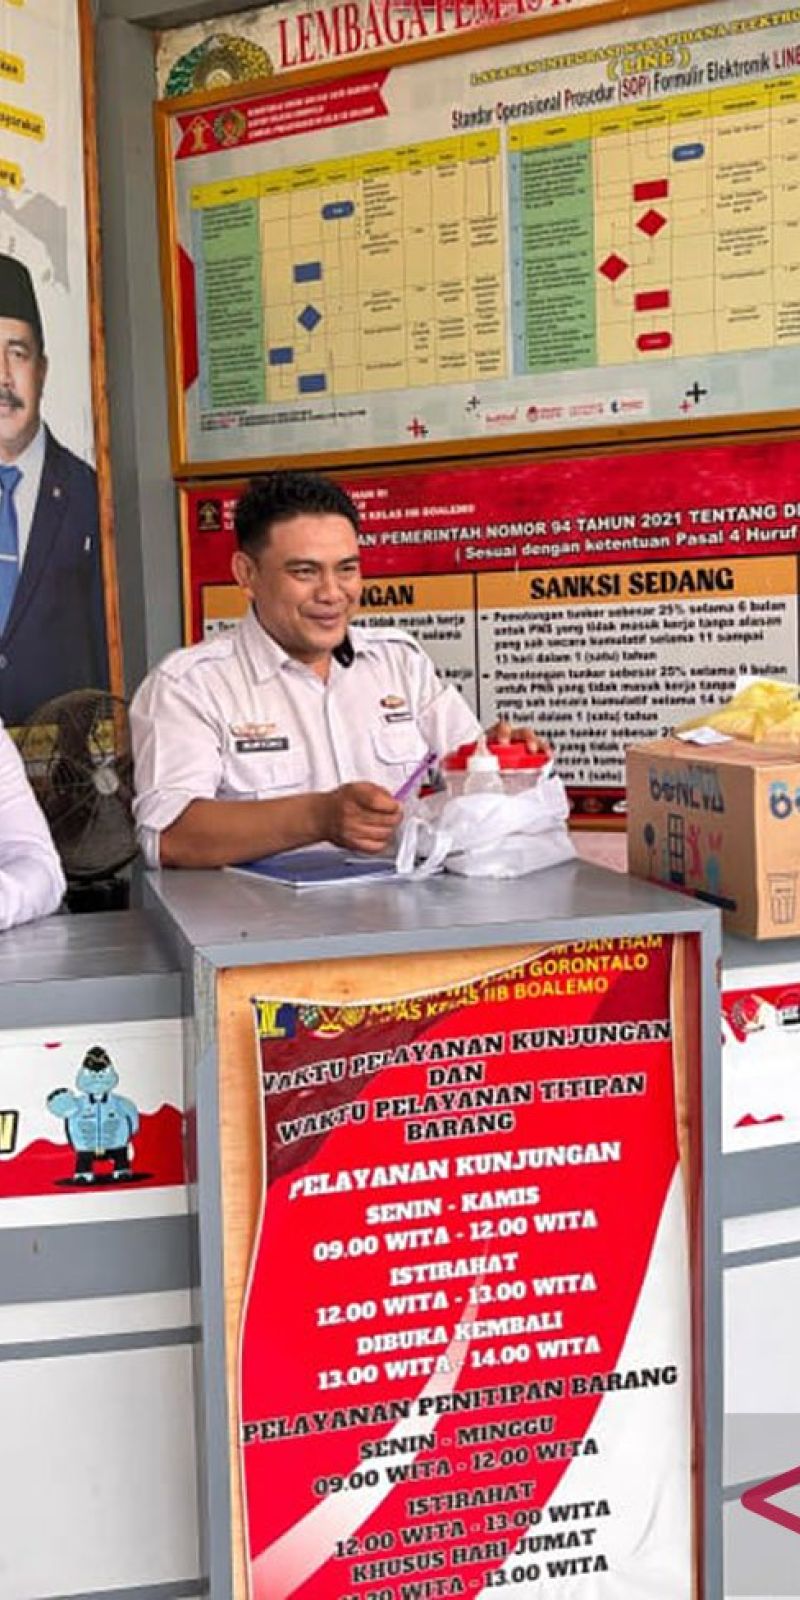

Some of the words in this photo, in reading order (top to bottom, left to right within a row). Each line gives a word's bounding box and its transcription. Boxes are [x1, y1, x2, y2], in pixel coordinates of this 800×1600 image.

[277, 0, 428, 68] LEMBAGA
[452, 106, 493, 130] Standar
[496, 91, 561, 123] Operasional
[564, 81, 616, 110] Prosedur
[653, 66, 704, 92] Formulir
[707, 52, 770, 84] Elektronik
[380, 526, 481, 546] PEMERINTAH
[486, 521, 546, 539] NOMOR
[551, 519, 571, 535] 94
[577, 514, 635, 532] TAHUN
[640, 511, 681, 528] 2021
[689, 503, 777, 524] TENTANG
[465, 544, 517, 560] Sesuai
[522, 541, 580, 558] dengan
[676, 530, 724, 546] Pasal
[729, 529, 741, 543] 4
[746, 525, 798, 542] Huruf
[530, 574, 620, 601] SANKSI
[628, 566, 734, 596] SEDANG
[514, 976, 609, 1000] BOALEMO
[530, 952, 649, 978] GORONTALO
[262, 1059, 344, 1096] WAKTU
[350, 1036, 503, 1077] PELAYANAN
[511, 1020, 672, 1051] KUNJUNGAN
[428, 1064, 484, 1087] DAN
[278, 1101, 366, 1145] WAKTU
[374, 1082, 533, 1120] PELAYANAN
[540, 1074, 646, 1101] TITIPAN
[405, 1111, 515, 1144] BARANG
[288, 1160, 450, 1200] PELAYANAN
[455, 1141, 622, 1178] KUNJUNGAN
[365, 1197, 442, 1226] SENIN
[461, 1185, 540, 1213] KAMIS
[313, 1236, 379, 1262] 09.00
[384, 1225, 451, 1252] WITA
[469, 1216, 528, 1241] 12.00
[533, 1208, 599, 1233] WITA
[389, 1251, 520, 1288] ISTIRAHAT
[316, 1300, 377, 1328] 12.00
[383, 1290, 450, 1317] WITA
[468, 1280, 527, 1306] 13.00
[532, 1271, 598, 1298] WITA
[356, 1327, 449, 1358] DIBUKA
[453, 1310, 564, 1342] KEMBALI
[317, 1365, 380, 1391] 13.00
[385, 1355, 451, 1380] WITA
[471, 1344, 530, 1369] 14.00
[535, 1335, 601, 1361] WITA
[241, 1400, 413, 1444] PELAYANAN
[417, 1378, 565, 1419] PENITIPAN
[571, 1363, 679, 1396] BARANG
[358, 1432, 437, 1462] SENIN
[456, 1416, 555, 1447] MINGGU
[312, 1468, 380, 1498] 09.00
[385, 1458, 452, 1485] WITA
[472, 1447, 530, 1473] 12.00
[536, 1437, 600, 1463] WITA
[405, 1481, 536, 1518] ISTIRAHAT
[334, 1531, 396, 1560] 12.00
[401, 1519, 466, 1548] WITA
[485, 1509, 543, 1534] 13.00
[548, 1499, 612, 1524] WITA
[351, 1554, 446, 1585] KHUSUS
[450, 1542, 512, 1567] HARI
[514, 1529, 598, 1557] JUMAT
[400, 1576, 464, 1600] WITA
[485, 1563, 541, 1588] 13.00
[546, 1554, 610, 1579] WITA
